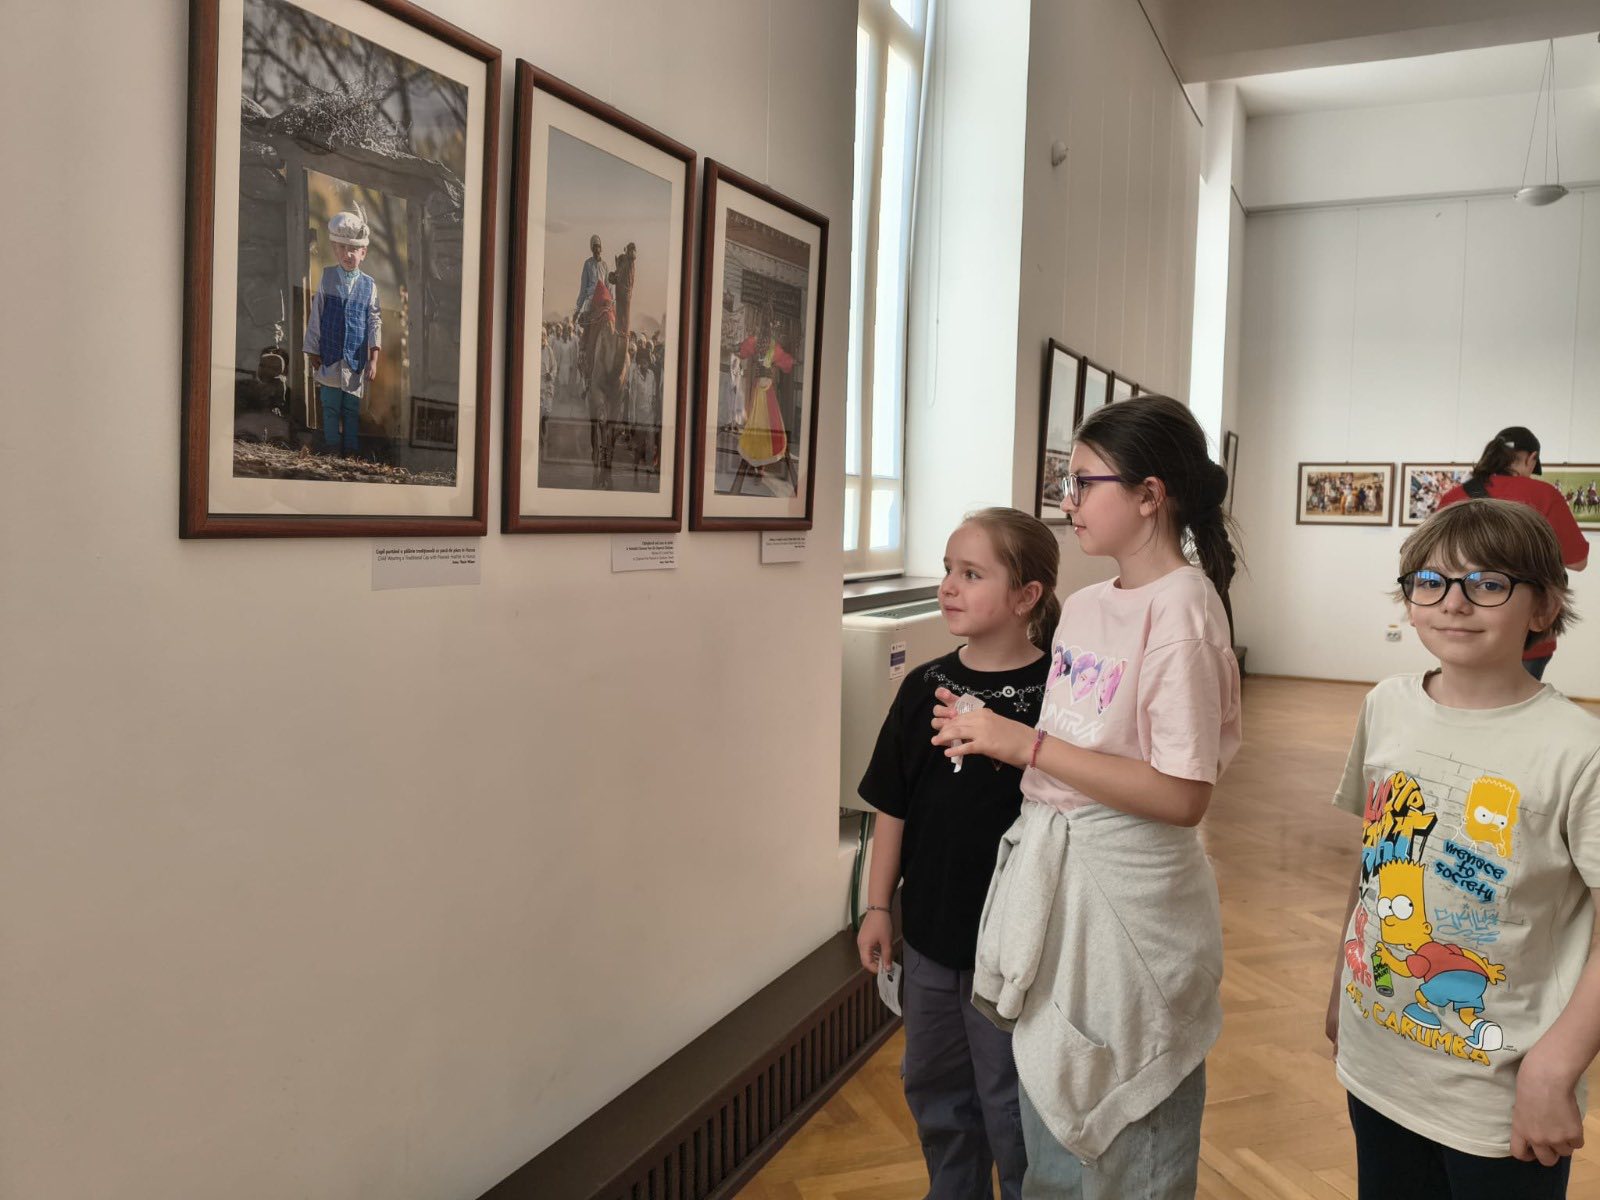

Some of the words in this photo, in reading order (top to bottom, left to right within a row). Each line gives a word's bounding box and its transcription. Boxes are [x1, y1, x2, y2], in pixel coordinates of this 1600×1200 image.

[1446, 841, 1505, 880] menace
[1456, 860, 1475, 878] to
[1435, 861, 1493, 903] society
